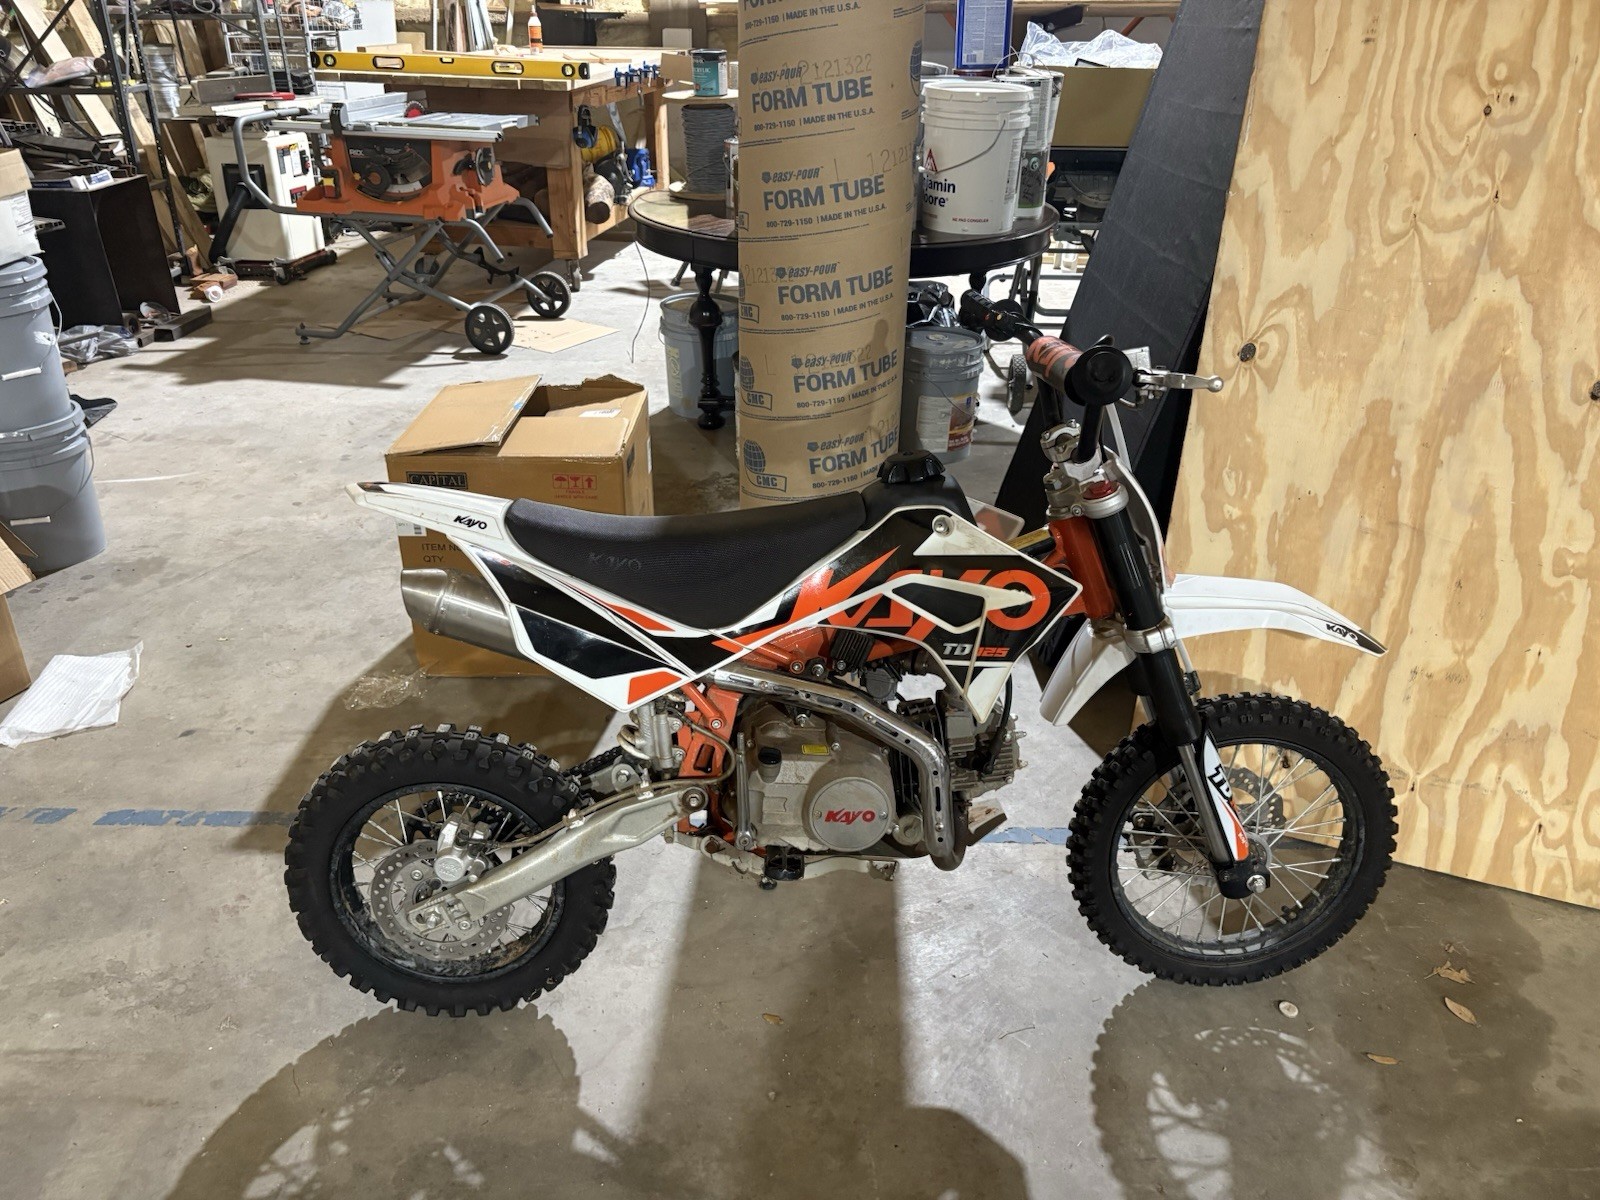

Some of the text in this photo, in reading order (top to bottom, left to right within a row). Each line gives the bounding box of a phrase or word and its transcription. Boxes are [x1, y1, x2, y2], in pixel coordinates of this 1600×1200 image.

[786, 9, 808, 20] MADE
[810, 7, 818, 16] IN
[819, 5, 836, 15] THE
[837, 1, 860, 12] U.S.A.
[752, 75, 873, 113] FORM TUBE
[803, 115, 826, 125] MADE
[827, 113, 836, 122] IN
[837, 110, 852, 120] THE
[854, 107, 876, 118] U.S.A.
[763, 174, 885, 211] FORM TUBE
[766, 203, 888, 228] 800-729-1150 MADE IN THE U.S.A.
[777, 265, 894, 305] FORM TUBE
[781, 310, 830, 321] 800-729-1150
[837, 304, 858, 315] MADE
[859, 302, 867, 310] IN
[867, 299, 880, 308] THE
[793, 368, 856, 393] FORM
[860, 349, 898, 382] TUBE
[746, 393, 765, 405] CMC
[796, 396, 846, 409] 800-729-1150
[851, 389, 870, 400] MADE
[870, 386, 877, 394] IN
[877, 381, 888, 392] THE
[809, 447, 868, 475] FORM
[410, 474, 465, 487] CAPITAL
[756, 475, 778, 487] CMC
[812, 475, 858, 489] 800-729-1150
[863, 465, 879, 477] MADE
[421, 543, 447, 551] ITEM
[943, 643, 973, 656] TD
